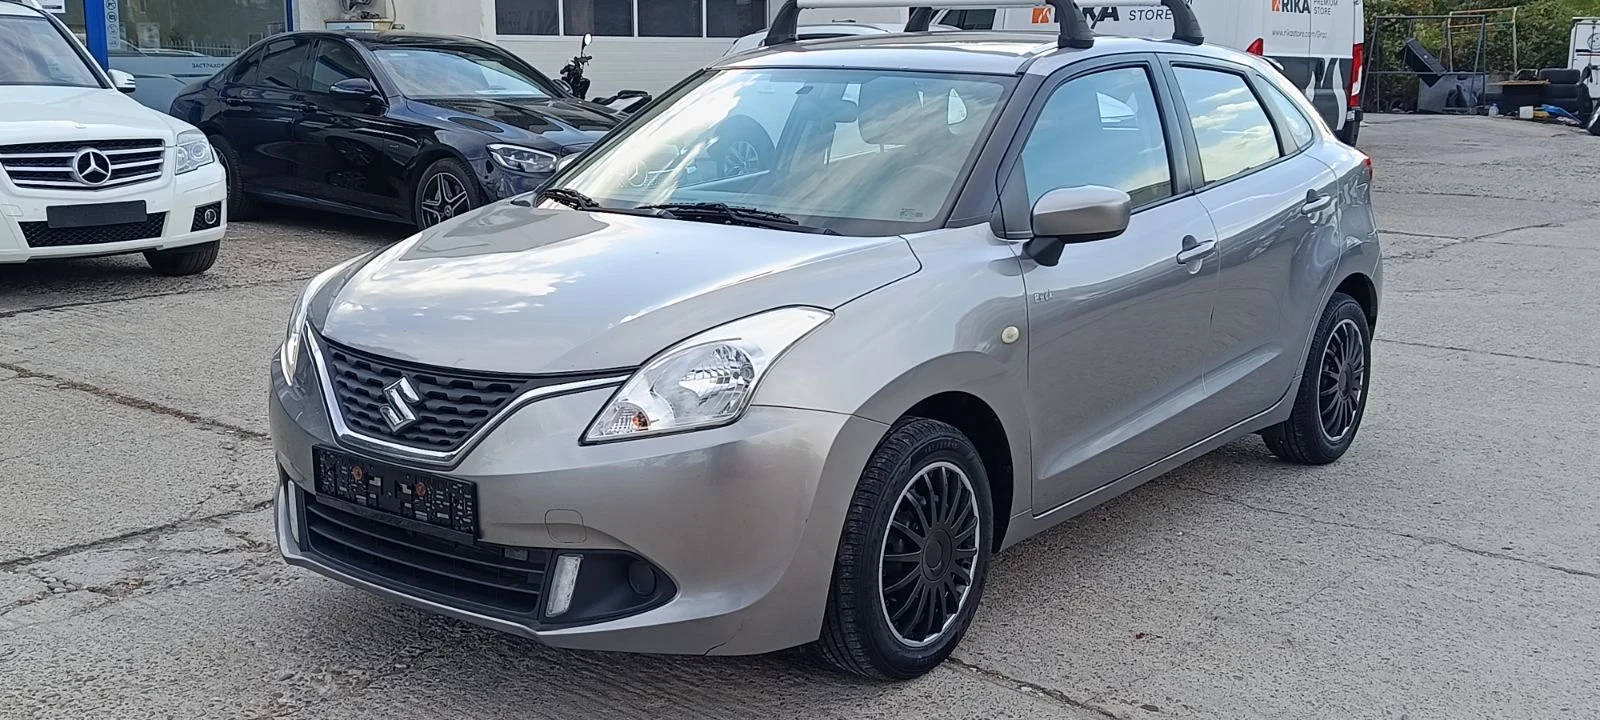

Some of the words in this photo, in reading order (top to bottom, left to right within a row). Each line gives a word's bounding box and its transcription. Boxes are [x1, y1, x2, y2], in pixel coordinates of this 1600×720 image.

[1282, 0, 1311, 14] RIKA
[1313, 6, 1331, 15] STORE
[1129, 9, 1172, 21] STORE
